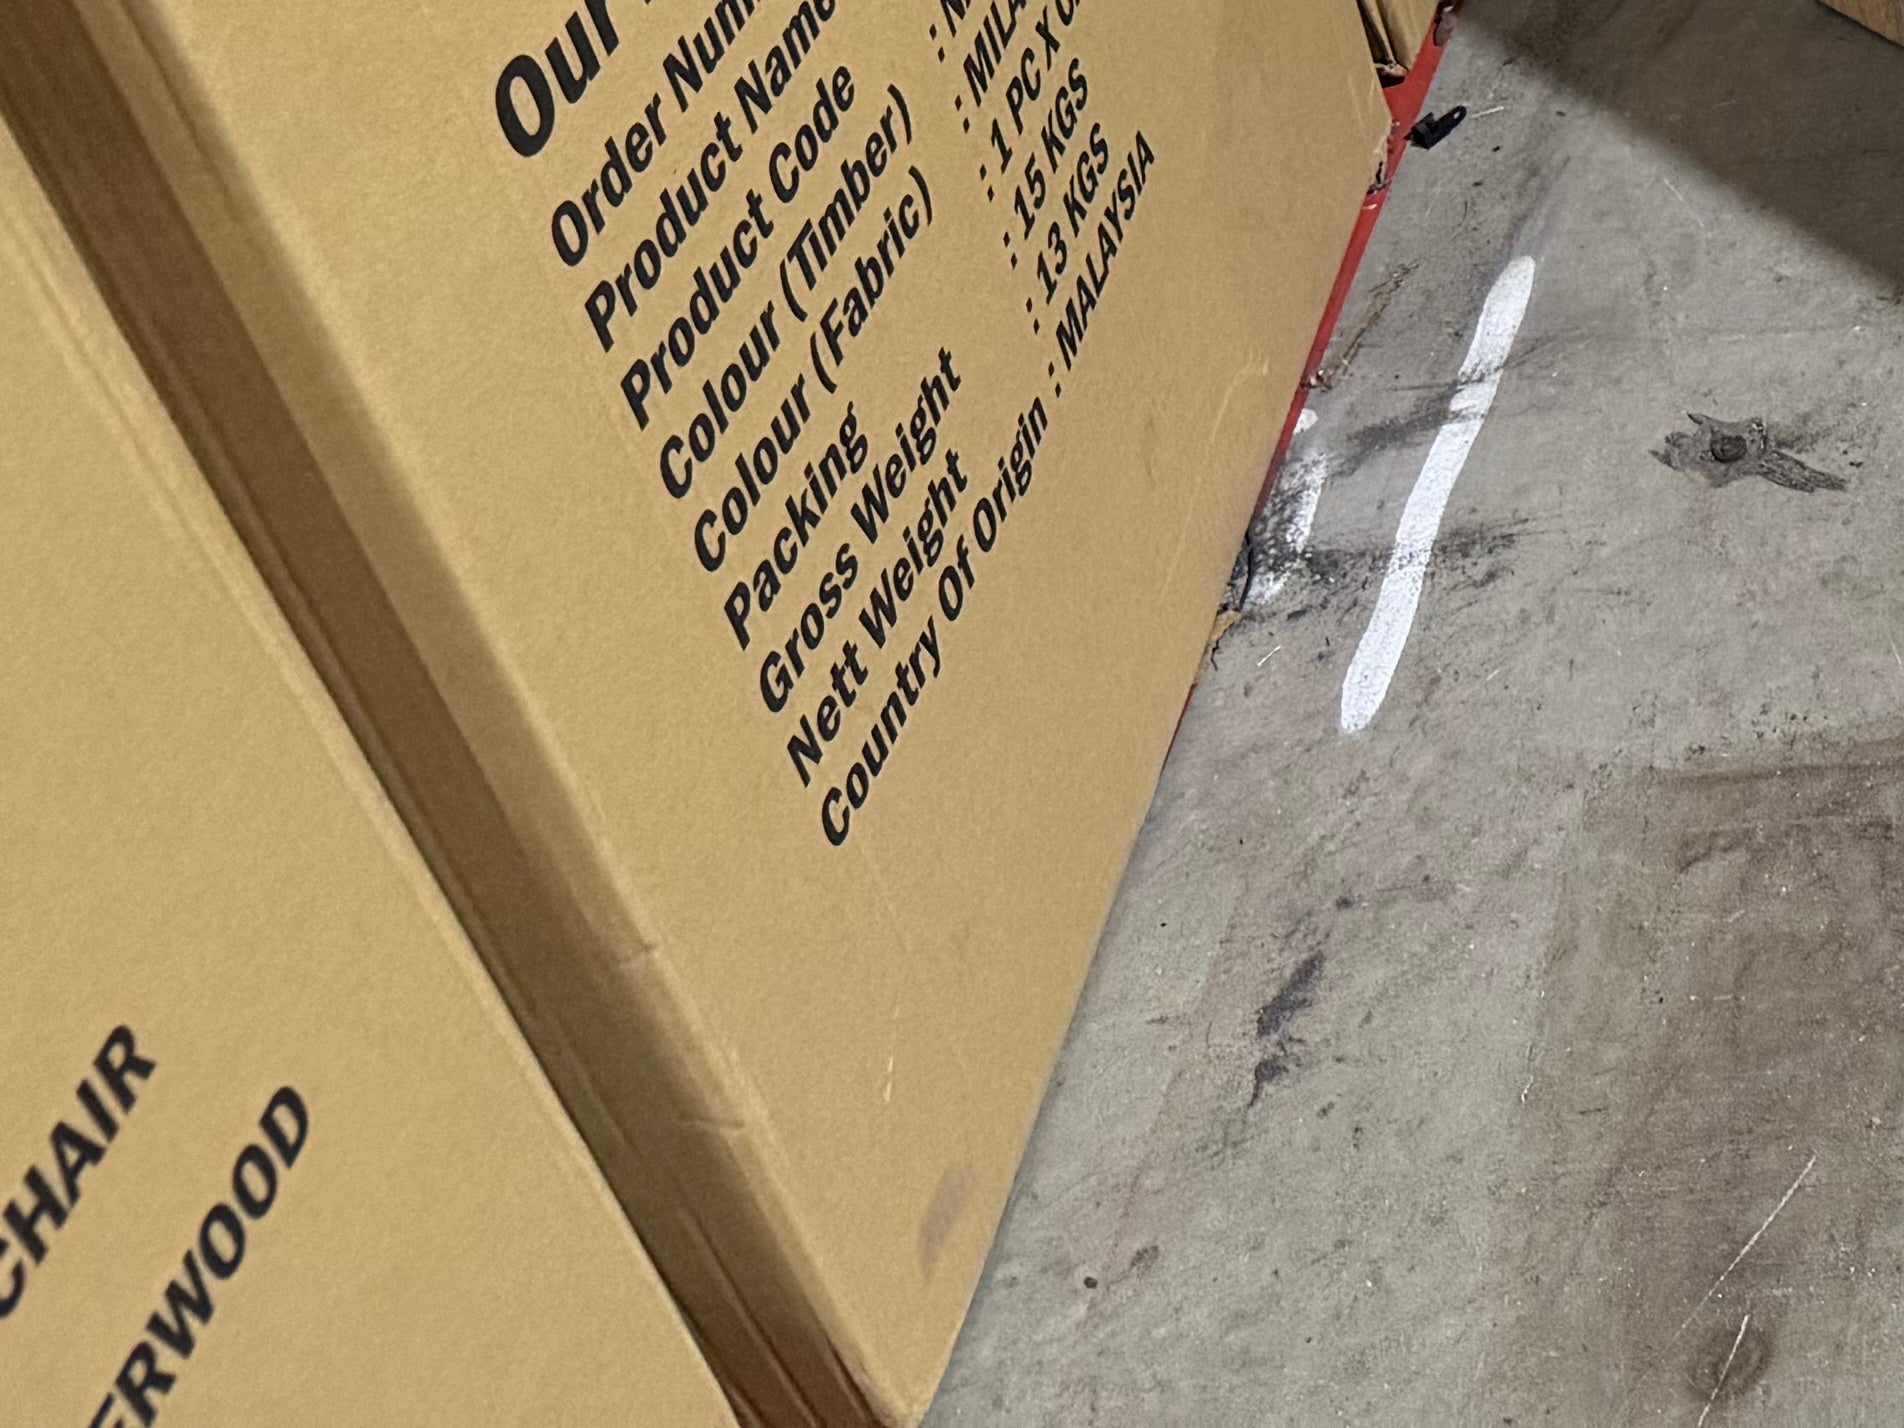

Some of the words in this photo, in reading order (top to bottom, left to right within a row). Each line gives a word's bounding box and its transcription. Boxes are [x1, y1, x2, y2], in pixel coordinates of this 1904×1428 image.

[549, 91, 667, 268] Order
[582, 110, 744, 354] Product
[618, 187, 775, 432] Product
[767, 64, 855, 204] Code
[658, 298, 781, 500] Colour
[777, 82, 913, 323] (Timber)
[692, 371, 811, 573] Colour
[808, 163, 933, 395] (Fabric)
[722, 399, 869, 652] Packing
[989, 116, 1014, 175] 1
[1004, 46, 1042, 136] PC
[1033, 3, 1061, 72] X
[758, 541, 859, 714] Gross
[848, 344, 962, 545] Weight
[1012, 150, 1047, 241] 15
[1039, 56, 1089, 175] KGS
[785, 638, 869, 788] Nett
[856, 446, 969, 650] Weight
[1035, 219, 1068, 306] 13
[1061, 120, 1109, 239] KGS
[819, 613, 941, 847] Country
[936, 532, 976, 622] Of
[971, 395, 1049, 553] Origin
[1054, 129, 1156, 372] MALAYSIA
